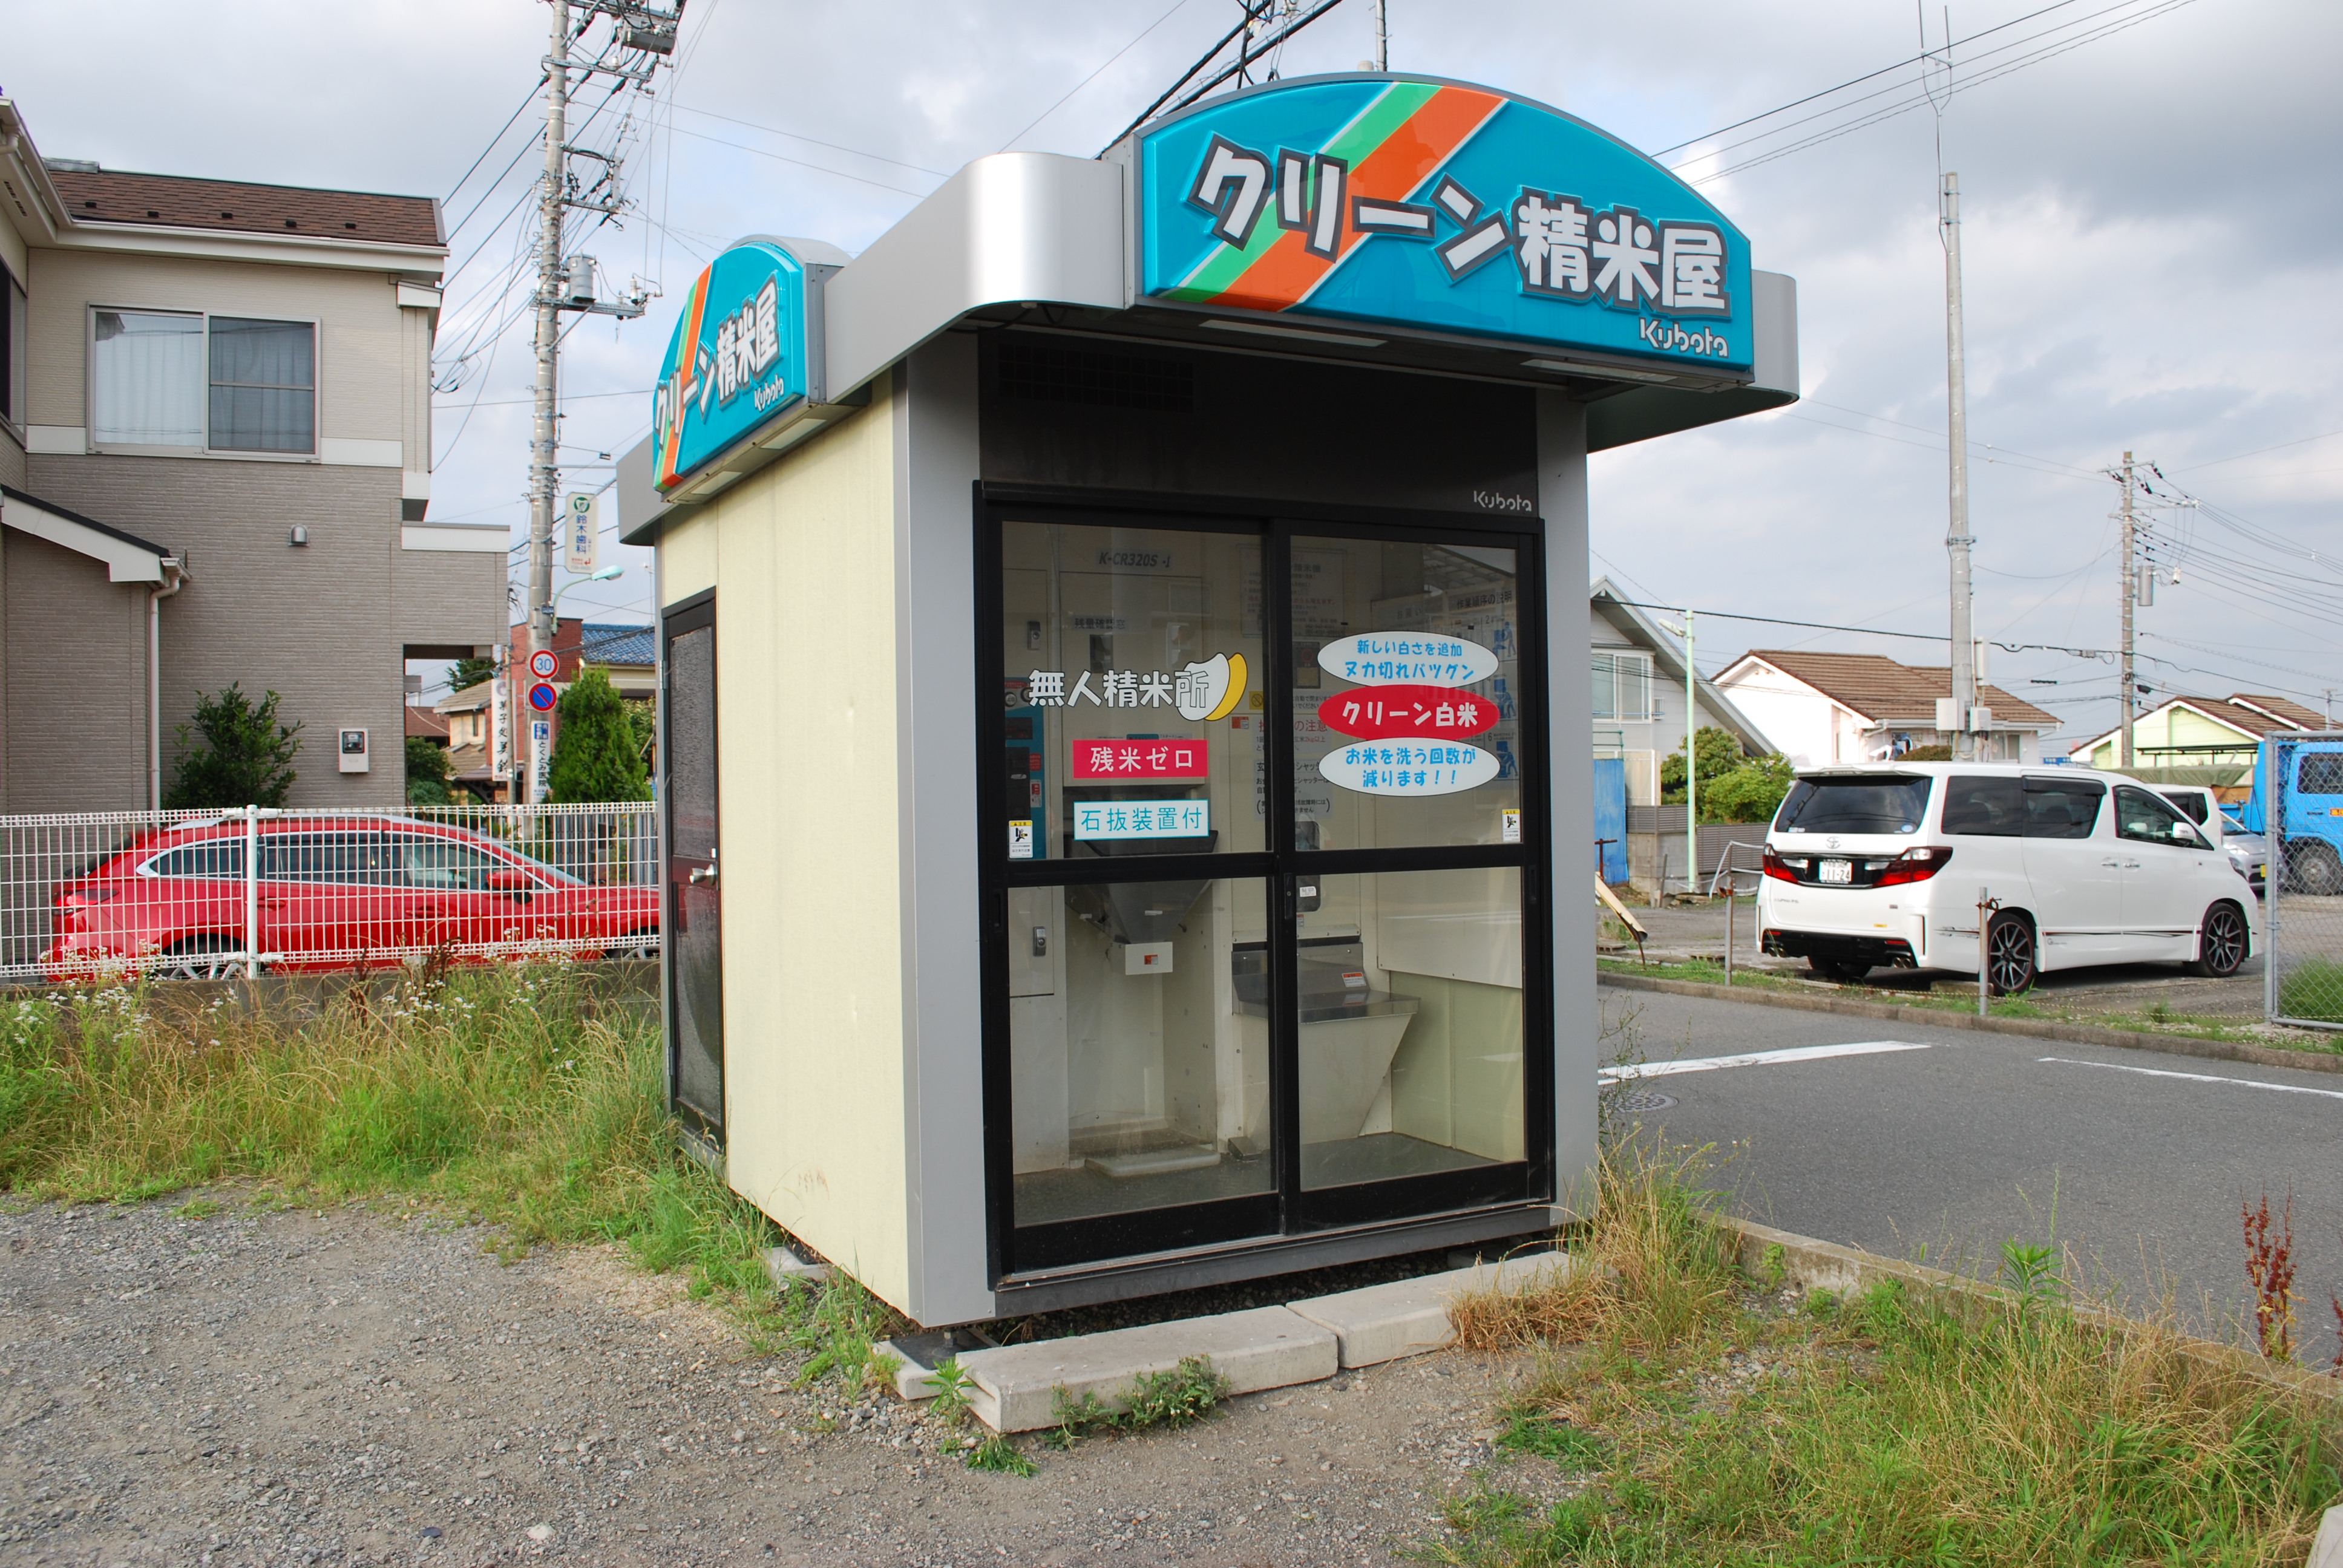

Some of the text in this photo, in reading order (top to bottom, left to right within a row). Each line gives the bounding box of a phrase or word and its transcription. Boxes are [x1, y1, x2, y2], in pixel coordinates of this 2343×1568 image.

[1192, 139, 1729, 312] クリーン精米屋
[1639, 318, 1729, 359] Kubota
[655, 279, 778, 451] クリーン精米屋
[754, 374, 785, 413] Kubota
[1473, 489, 1532, 512] Kubota
[576, 514, 588, 555] 鈴木歯科
[1098, 551, 1158, 567] K-CR320S
[1357, 639, 1463, 658] 新しい白さを追加
[536, 657, 552, 671] 30
[1345, 661, 1475, 681] ヌカ切れバツグン
[1028, 668, 1209, 708] 無人精米所
[1342, 701, 1478, 728] クリーン白米
[1090, 746, 1193, 773] 残米ゼロ
[1345, 746, 1476, 766] お米を洗う回数が
[1081, 806, 1202, 832] 石抜装置付
